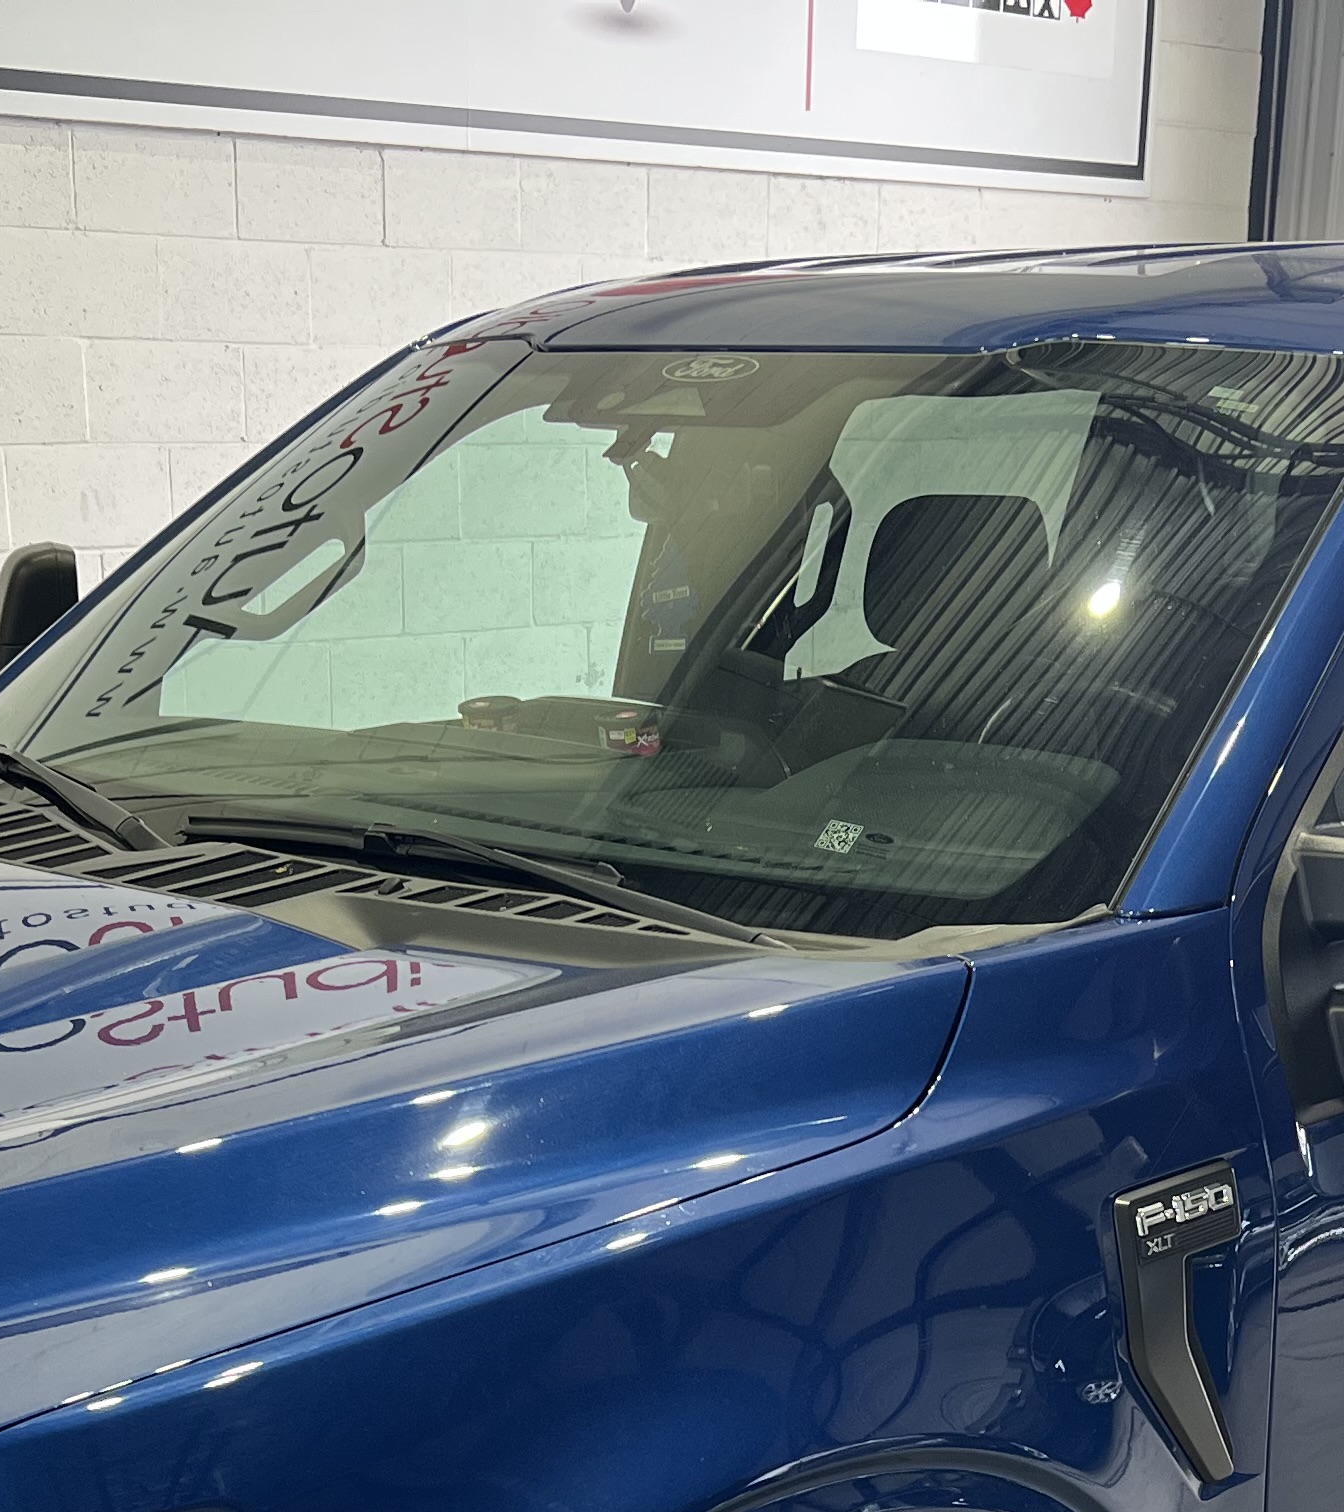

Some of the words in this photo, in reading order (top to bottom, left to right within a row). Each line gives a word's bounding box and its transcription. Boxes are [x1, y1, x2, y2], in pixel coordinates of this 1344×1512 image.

[674, 357, 745, 378] Ford
[1136, 1184, 1234, 1237] F-150
[1146, 1232, 1175, 1256] XLT
